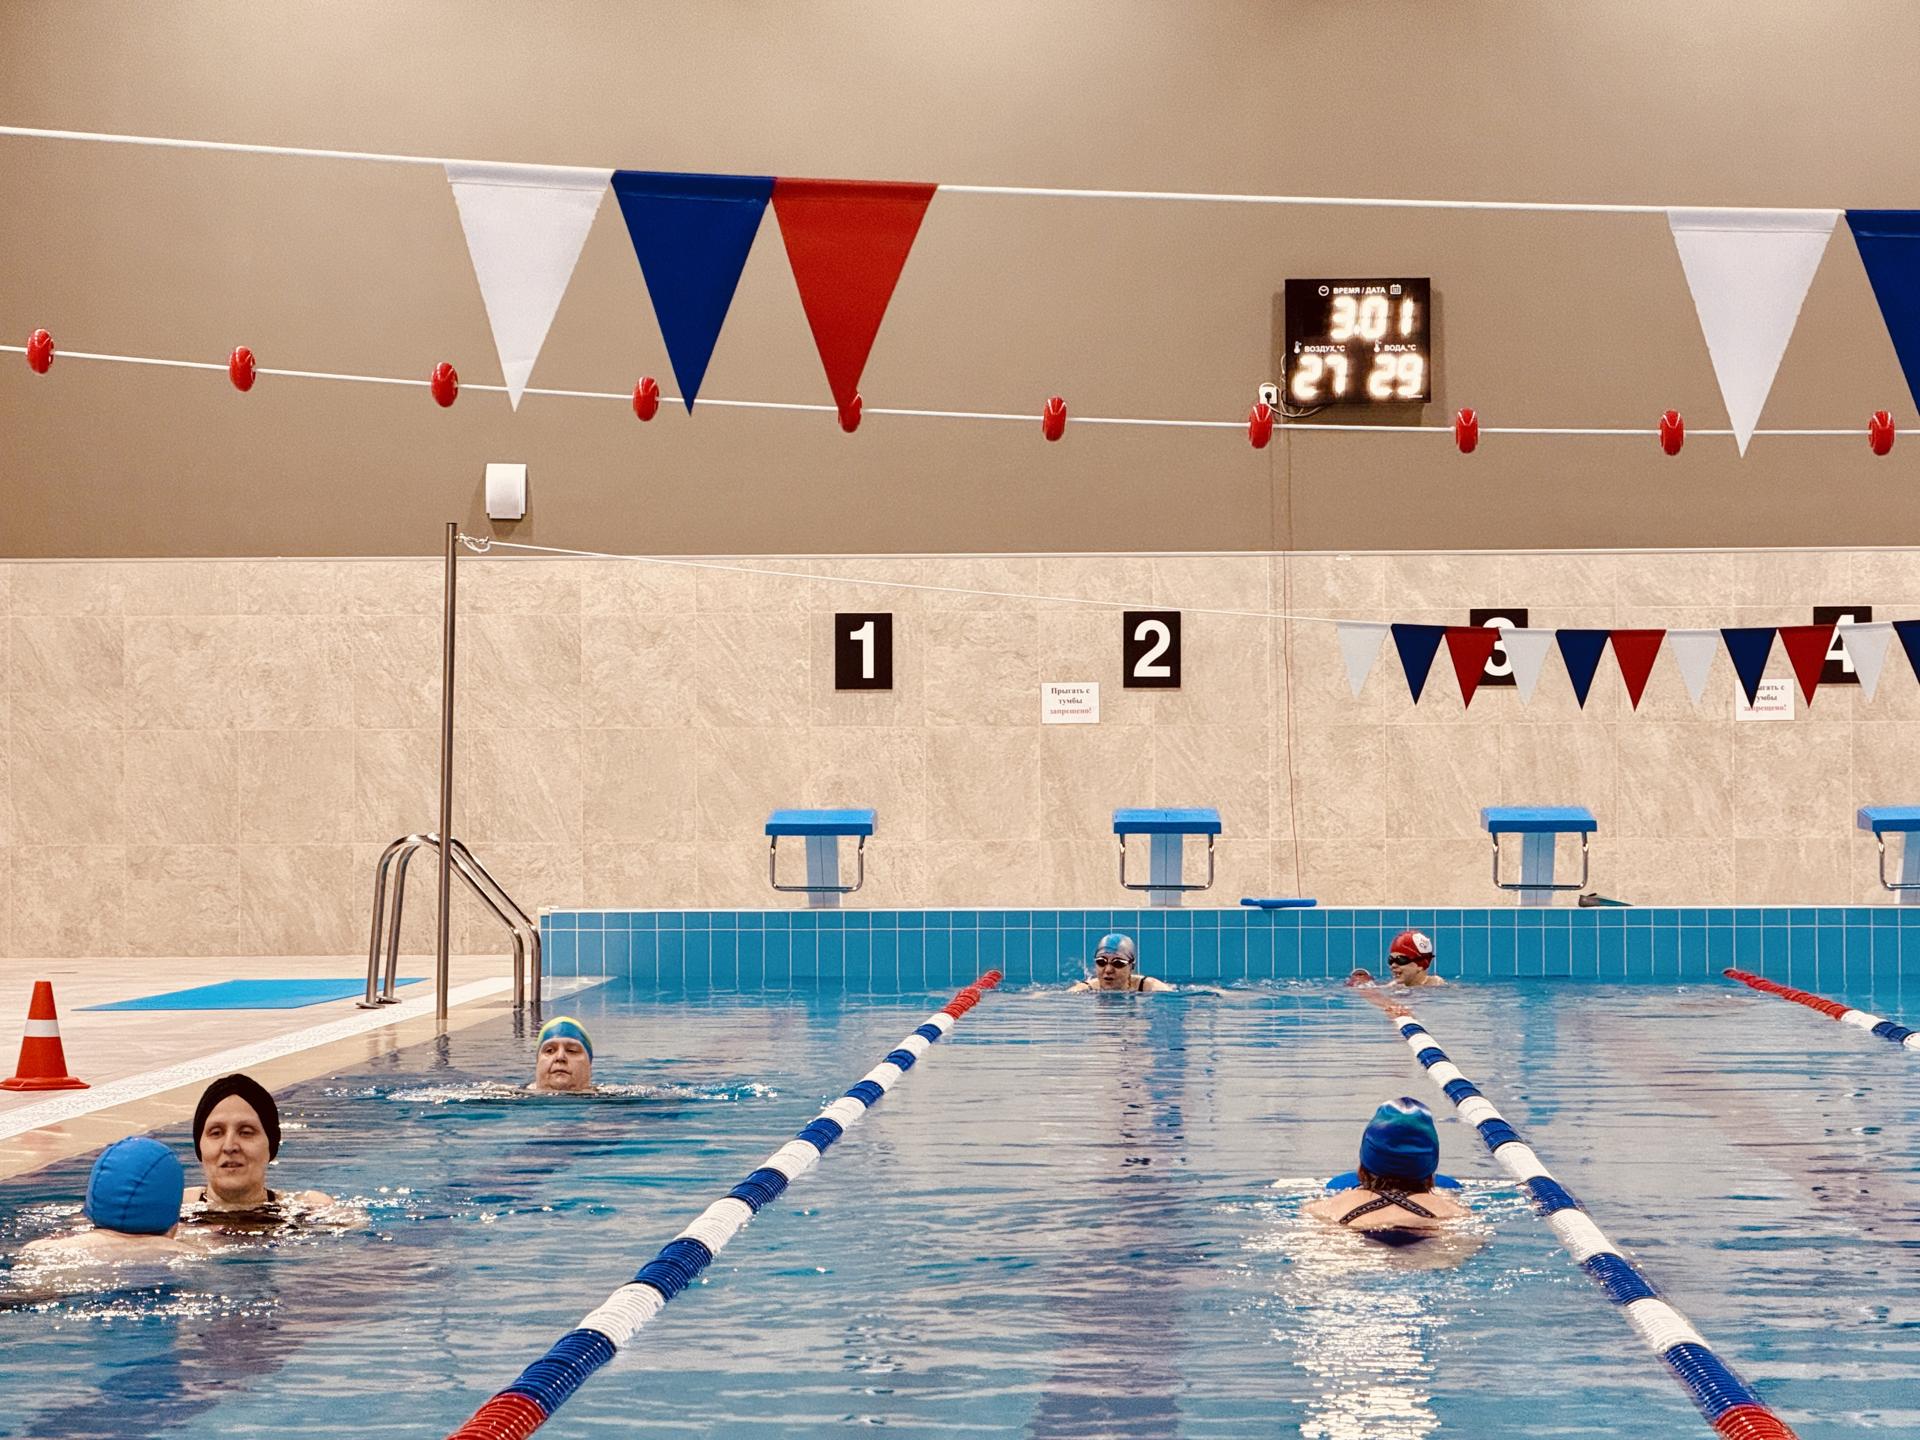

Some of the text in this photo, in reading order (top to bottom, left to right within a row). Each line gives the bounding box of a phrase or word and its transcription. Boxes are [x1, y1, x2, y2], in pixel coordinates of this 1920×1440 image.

[1293, 354, 1348, 399] 27
[1368, 353, 1423, 398] 29
[850, 621, 874, 679] 1
[1133, 619, 1171, 677] 2
[1051, 687, 1084, 695] Прыгать
